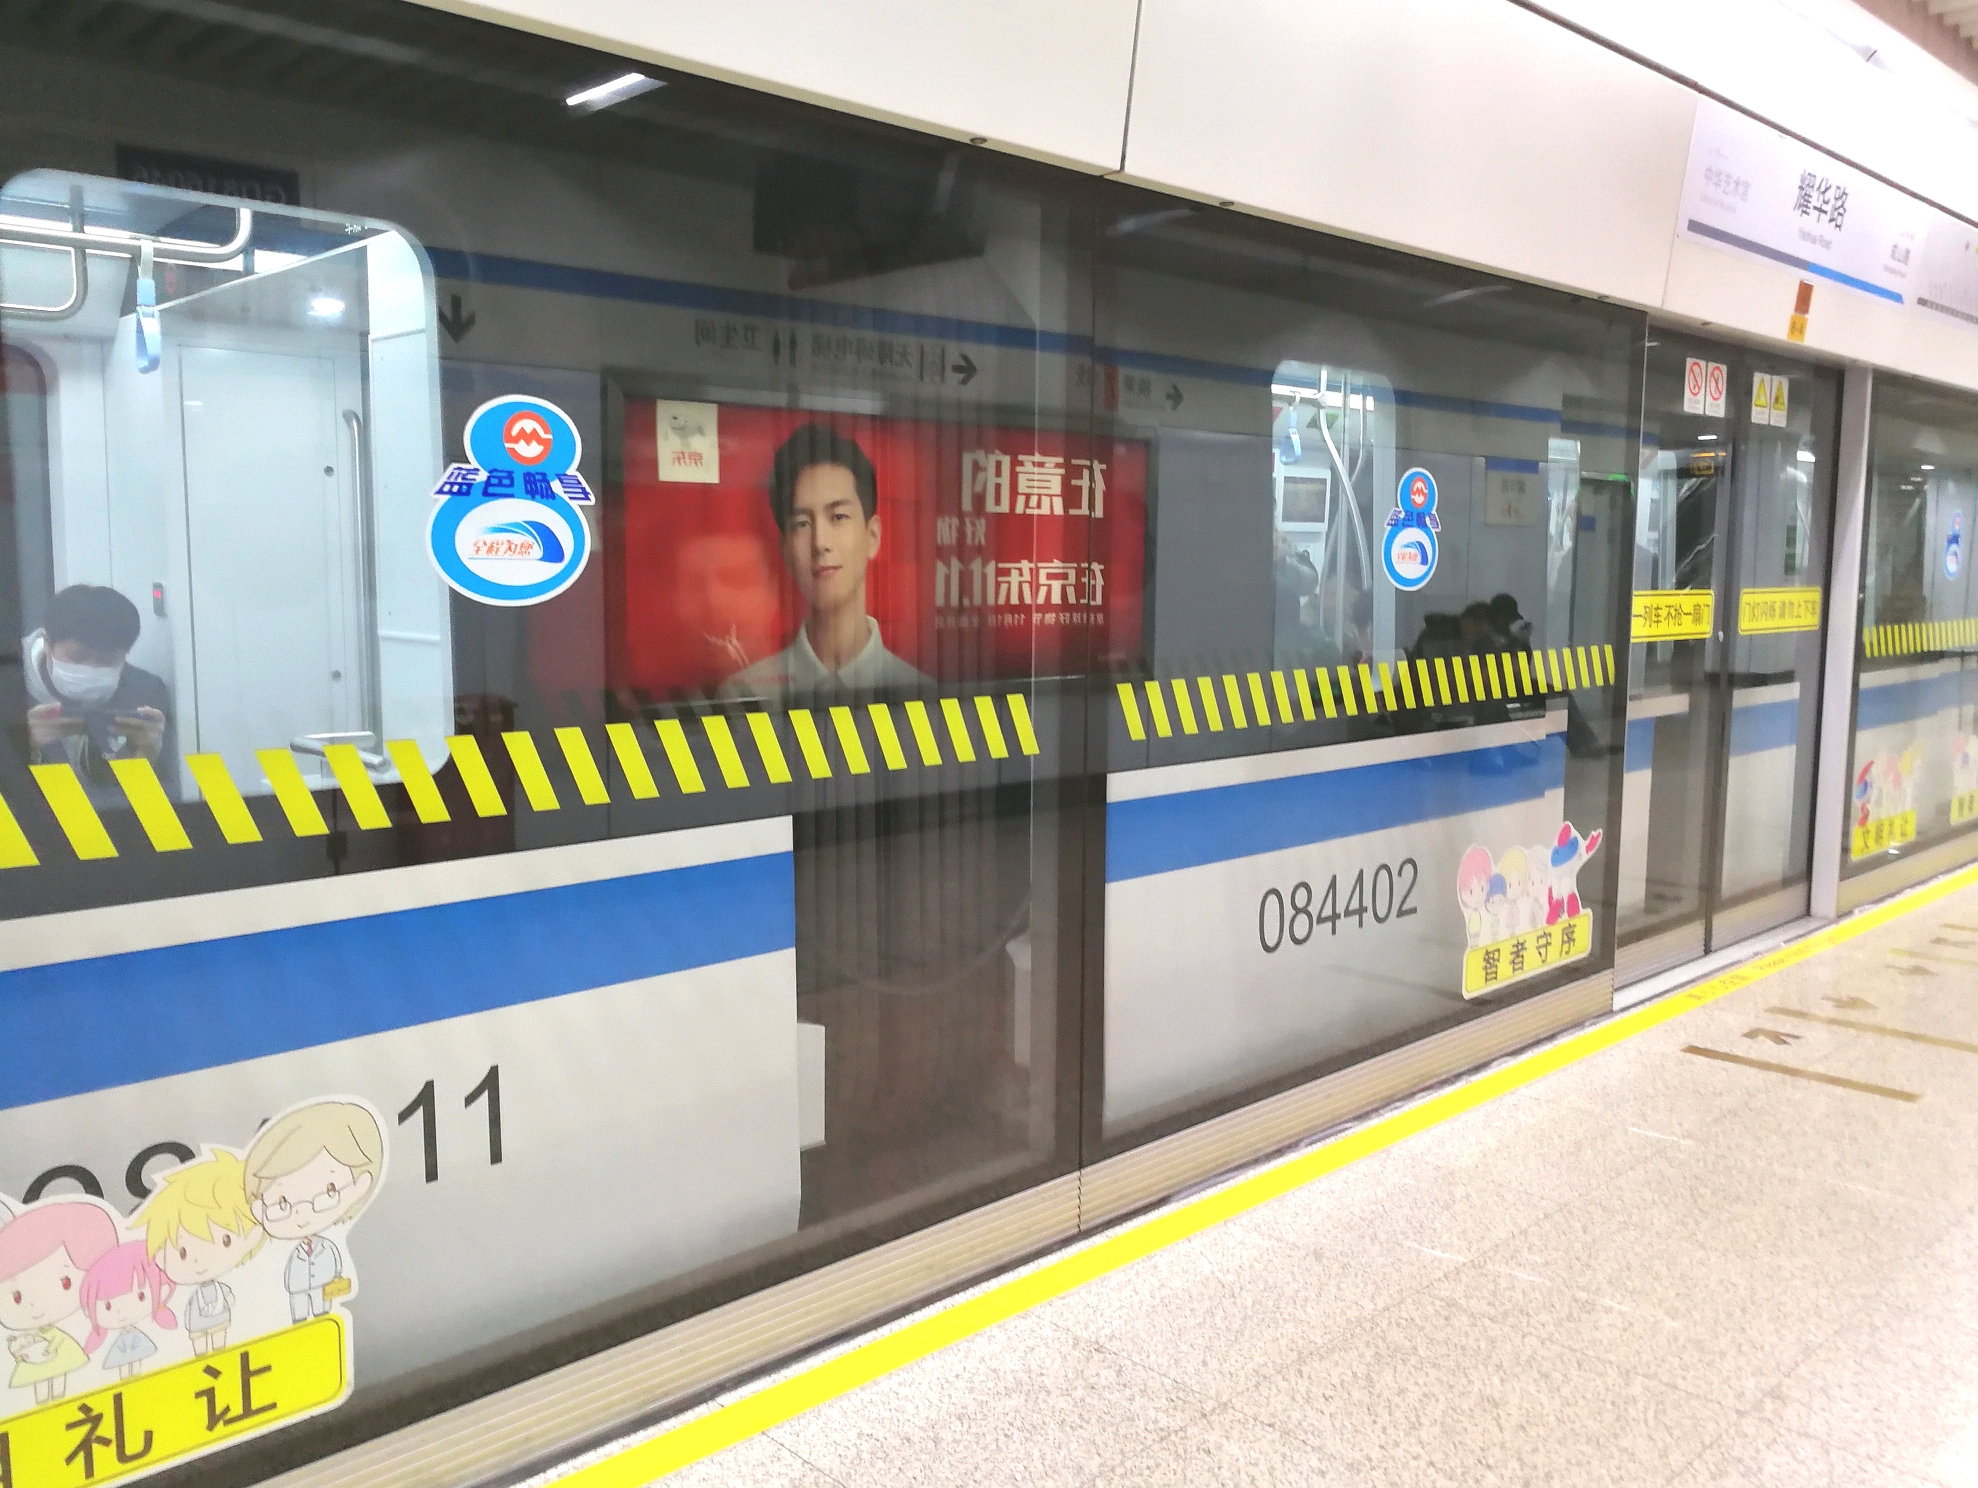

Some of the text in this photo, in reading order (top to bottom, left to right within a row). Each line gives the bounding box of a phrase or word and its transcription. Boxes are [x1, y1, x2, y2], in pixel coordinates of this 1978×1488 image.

[1794, 169, 1849, 231] 耀华路
[1258, 857, 1418, 954] 084402
[1482, 922, 1578, 985] 智者守序
